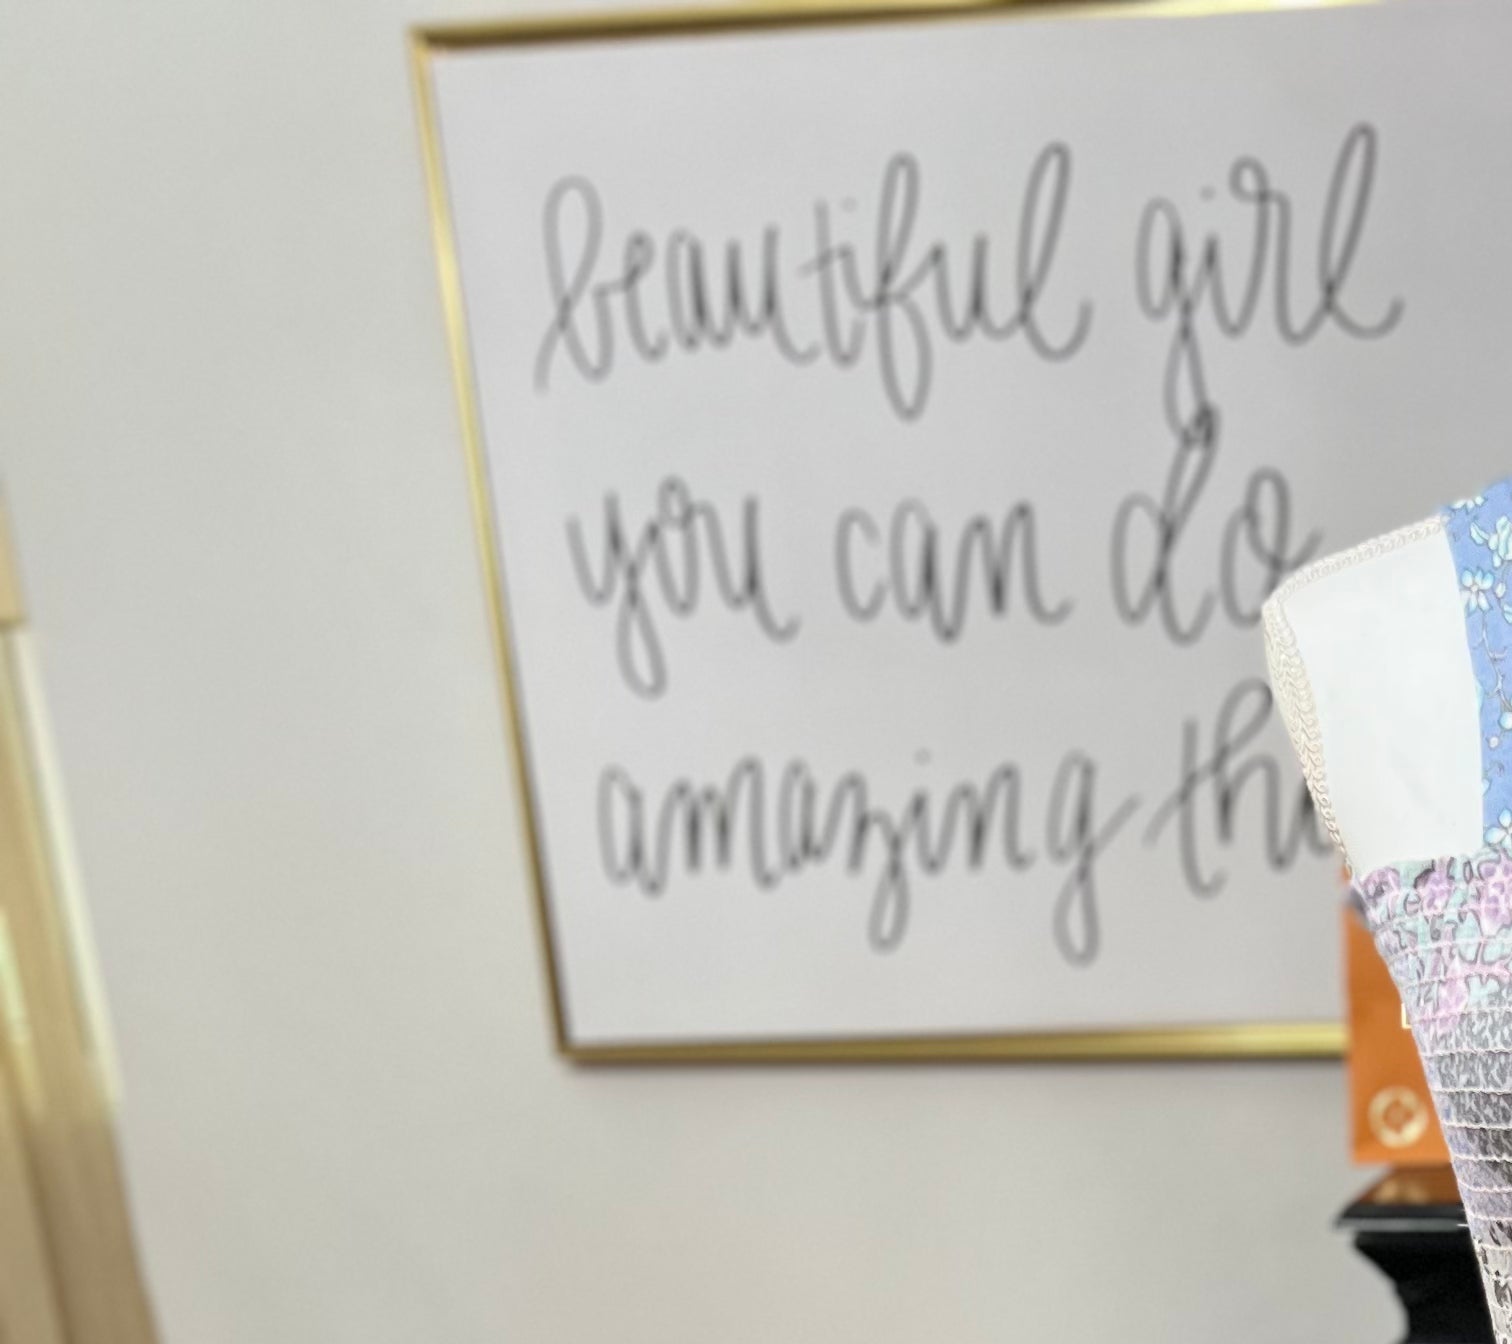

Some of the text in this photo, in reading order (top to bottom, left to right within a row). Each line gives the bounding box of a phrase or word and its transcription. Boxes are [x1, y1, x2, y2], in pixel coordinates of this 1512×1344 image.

[536, 122, 1406, 452] beautiful girl
[565, 405, 1324, 700] you can do
[598, 750, 1140, 968] amazing
